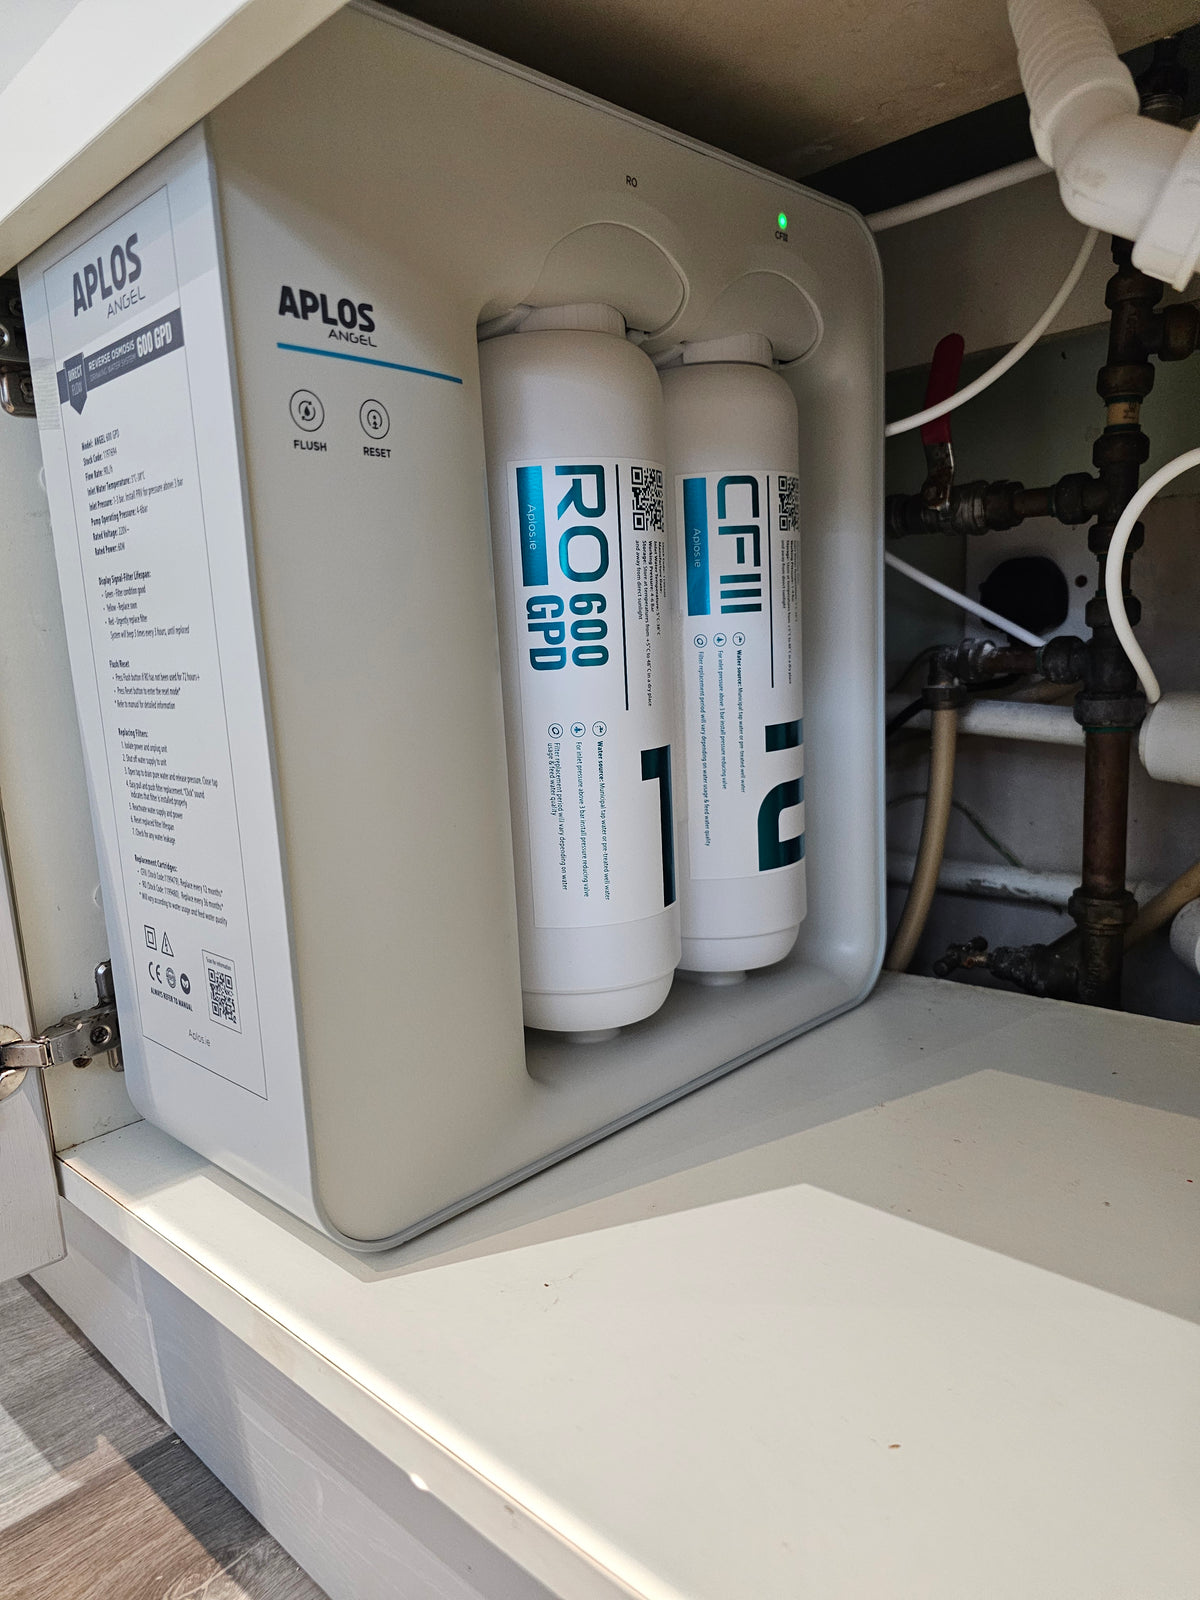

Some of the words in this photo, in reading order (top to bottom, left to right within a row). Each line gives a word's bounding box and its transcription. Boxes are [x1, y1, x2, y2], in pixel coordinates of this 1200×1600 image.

[625, 175, 638, 188] RO
[73, 232, 142, 317] APLOS
[107, 286, 146, 319] ANGEL
[278, 285, 376, 333] APLOS
[136, 331, 153, 356] 600
[153, 321, 172, 348] GPD
[328, 329, 378, 347] ANGEL
[88, 352, 110, 370] REVERSE
[110, 339, 134, 359] OSMOSIS
[67, 364, 82, 381] DIRECT
[71, 381, 82, 395] FLOW
[81, 439, 93, 450] Model:
[94, 434, 105, 445] ANGEL
[293, 440, 328, 452] FLUSH
[82, 455, 93, 466] Stock
[92, 452, 103, 462] Code:
[363, 446, 392, 458] RESET
[84, 472, 93, 480] Flow
[93, 469, 103, 478] Rate:
[86, 487, 96, 496] Inlet
[95, 484, 106, 493] Water
[106, 477, 129, 489] Temperature:
[88, 502, 97, 511] Inlet
[96, 499, 112, 508] Pressure:
[147, 484, 162, 495] pressure
[162, 481, 174, 490] above
[90, 517, 101, 525] Pump
[100, 513, 119, 524] Operating
[118, 509, 136, 518] Pressure:
[526, 503, 537, 550] Aplos.ie
[555, 464, 609, 583] RO
[92, 531, 103, 540] Rated
[102, 529, 117, 538] Voltage:
[94, 546, 105, 555] Rated
[104, 545, 117, 553] Power:
[642, 540, 650, 565] Storage:
[693, 528, 702, 568] Aplos.ie
[717, 475, 762, 614] CFIII
[635, 552, 643, 566] away
[98, 576, 111, 585] Display
[110, 572, 133, 584] Signal-Filter
[133, 570, 151, 580] Lifespan:
[643, 566, 651, 582] Store
[643, 587, 651, 623] temperatures
[525, 594, 567, 671] GPD
[568, 593, 609, 667] 600
[117, 727, 135, 738] Replacing
[134, 728, 148, 737] Filters:
[700, 736, 708, 763] depending
[554, 758, 563, 793] replacement
[556, 794, 564, 812] period
[599, 783, 607, 809] Municipal
[575, 742, 583, 750] For
[581, 860, 589, 883] reducing
[559, 836, 567, 866] depending
[134, 854, 157, 866] Replacement
[156, 859, 177, 872] Cartridges:
[561, 866, 567, 874] on
[150, 987, 163, 997] ALWAYS
[162, 992, 173, 1002] REFER
[172, 996, 178, 1004] TO
[177, 999, 192, 1011] MANUAL
[188, 1029, 210, 1046] Aplos.ie
